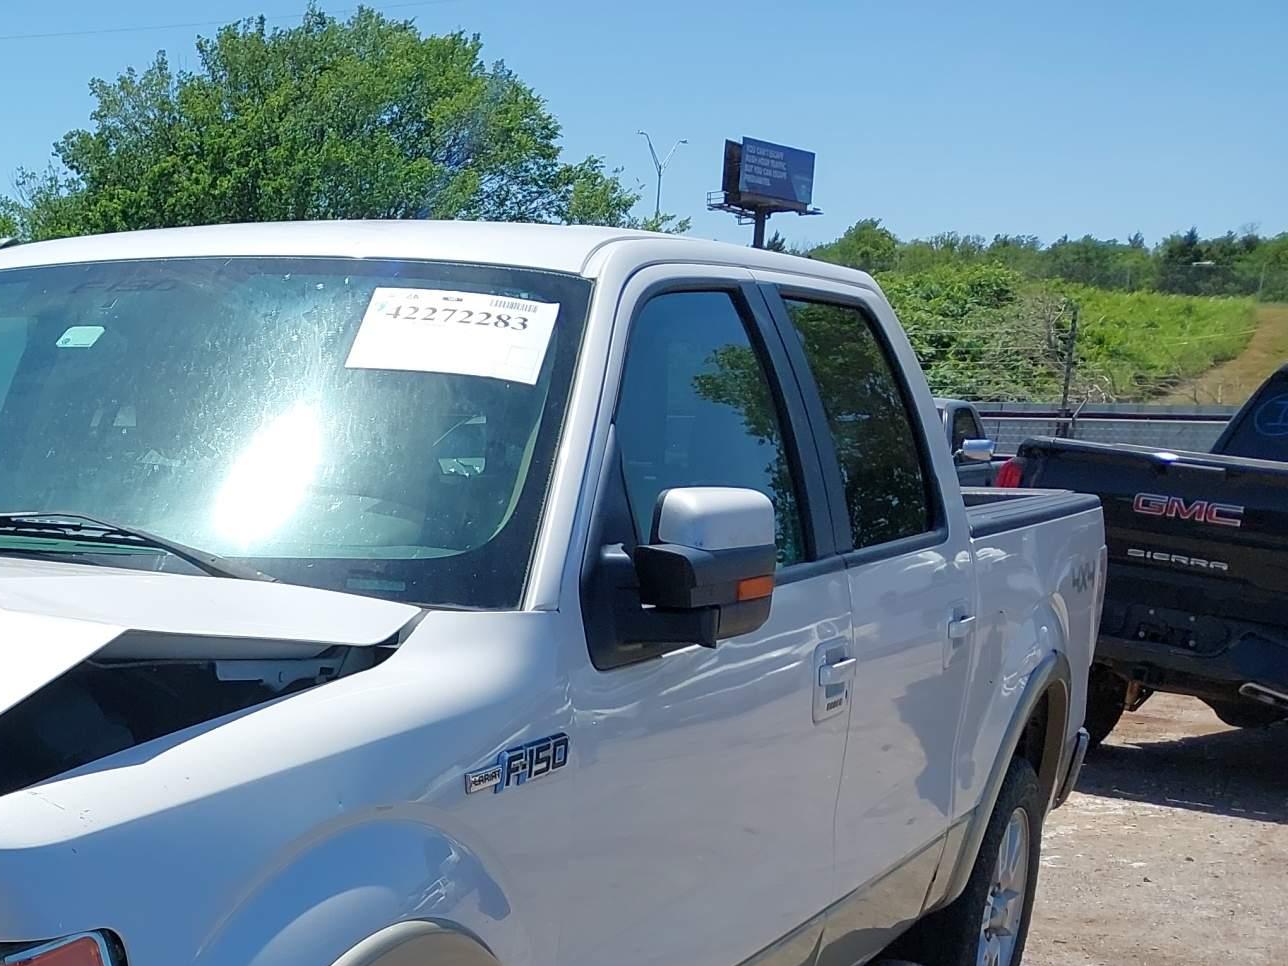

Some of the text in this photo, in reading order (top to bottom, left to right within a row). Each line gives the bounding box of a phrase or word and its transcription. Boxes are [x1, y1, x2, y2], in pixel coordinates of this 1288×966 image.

[385, 305, 529, 331] 42272283
[1133, 493, 1244, 527] GMC
[1127, 548, 1229, 571] SIERRA
